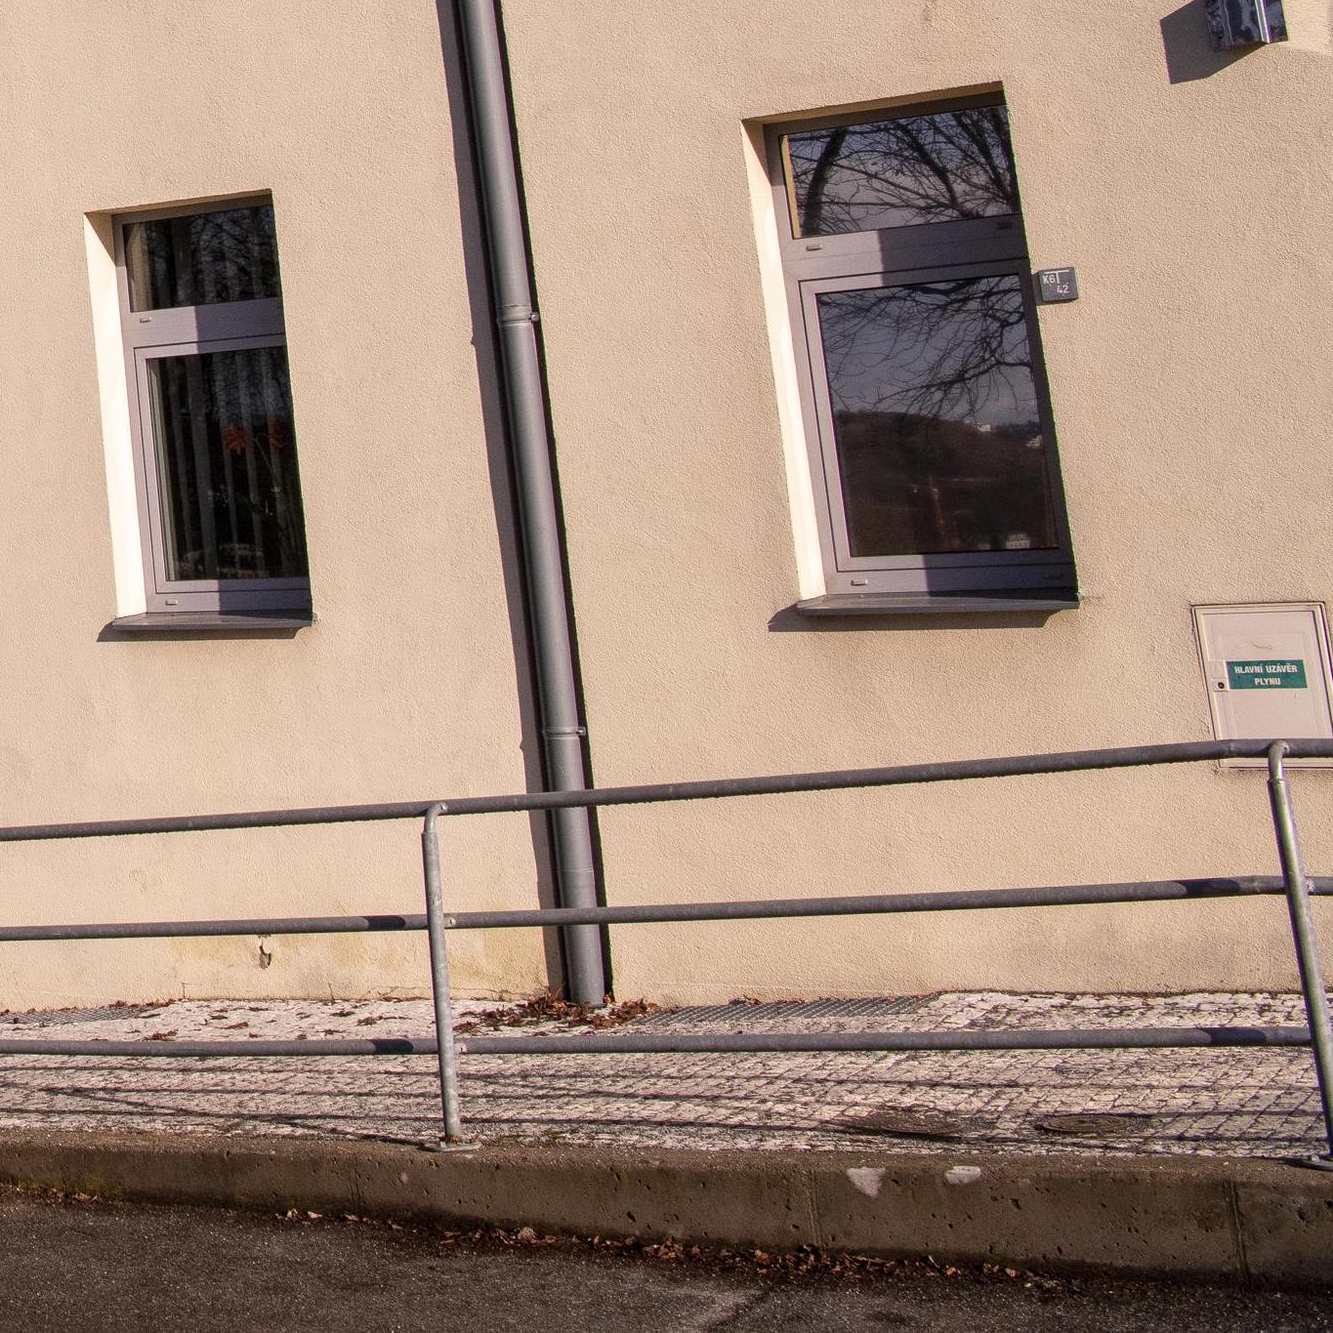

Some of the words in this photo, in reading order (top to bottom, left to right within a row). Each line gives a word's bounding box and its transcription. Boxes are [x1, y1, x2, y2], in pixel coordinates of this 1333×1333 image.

[1234, 663, 1264, 674] HLAVNÍ
[1265, 662, 1298, 673] UZÁVĚR
[1254, 677, 1281, 686] PLYNU
